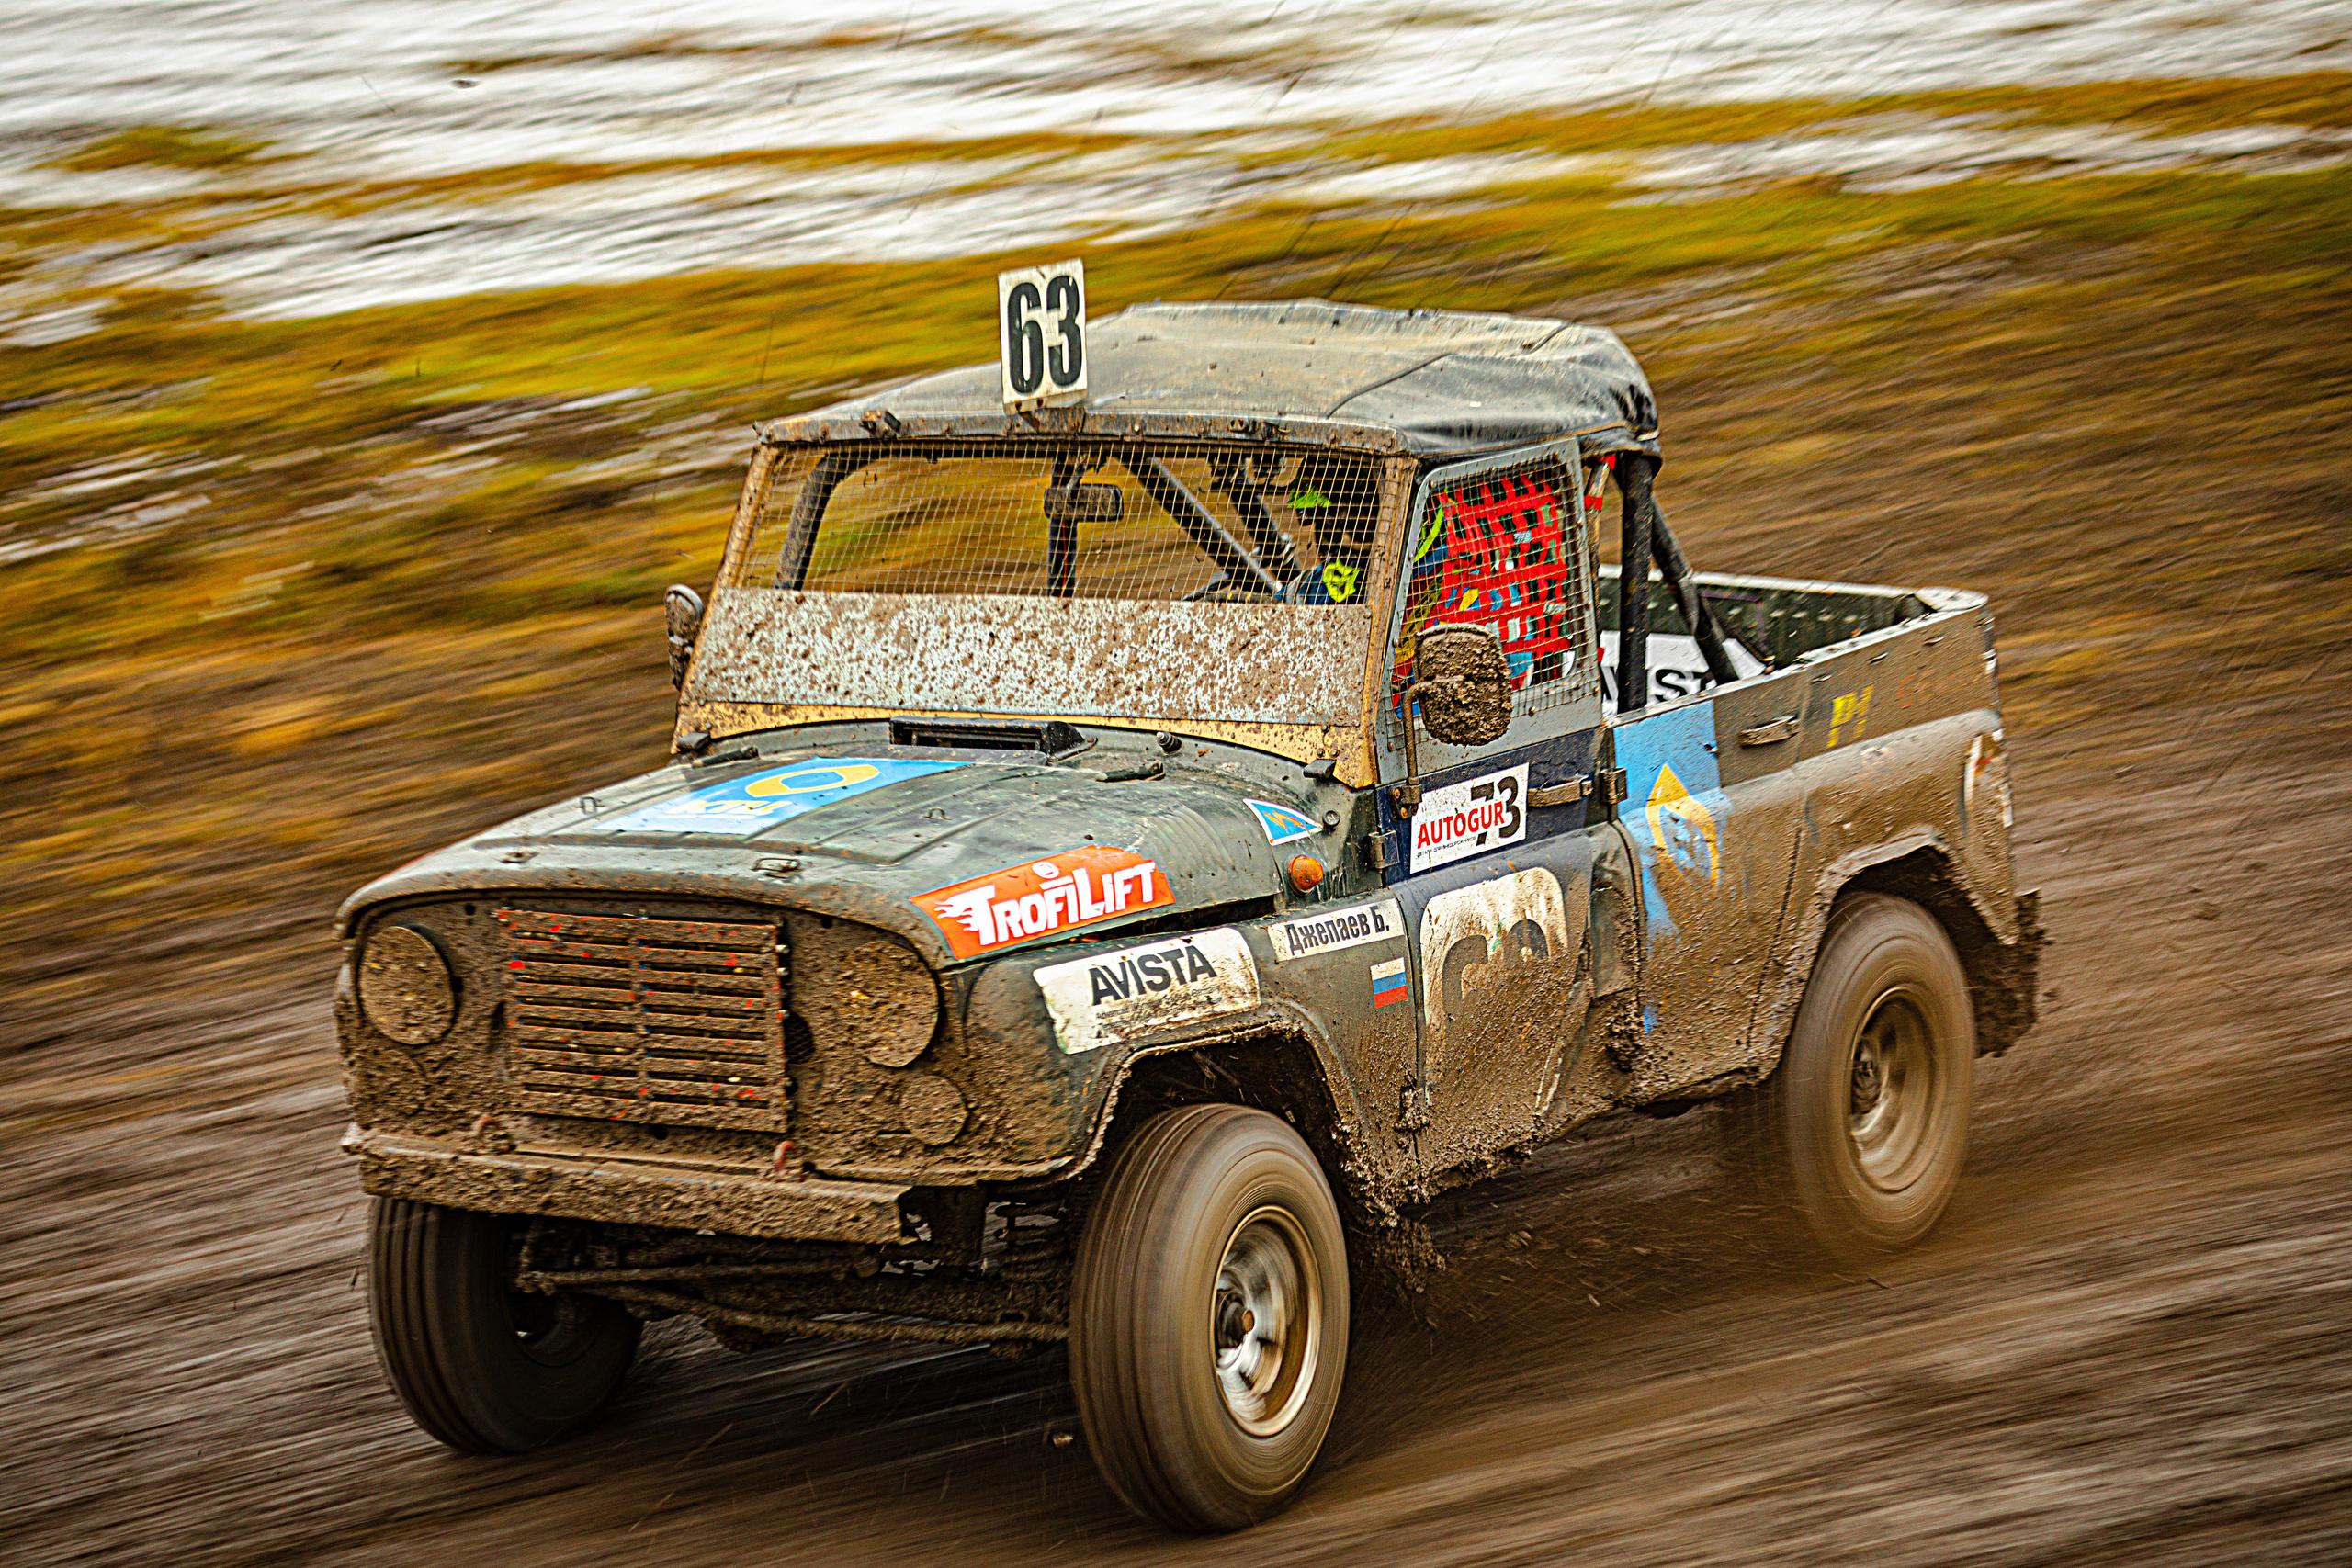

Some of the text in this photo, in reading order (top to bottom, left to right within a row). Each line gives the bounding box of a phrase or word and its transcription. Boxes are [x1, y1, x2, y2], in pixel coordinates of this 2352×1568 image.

[1008, 275, 1082, 394] 63
[1417, 801, 1505, 849] AUTOGUR
[1284, 905, 1389, 955] Джепаев Б.
[1089, 945, 1218, 1006] AVISTA
